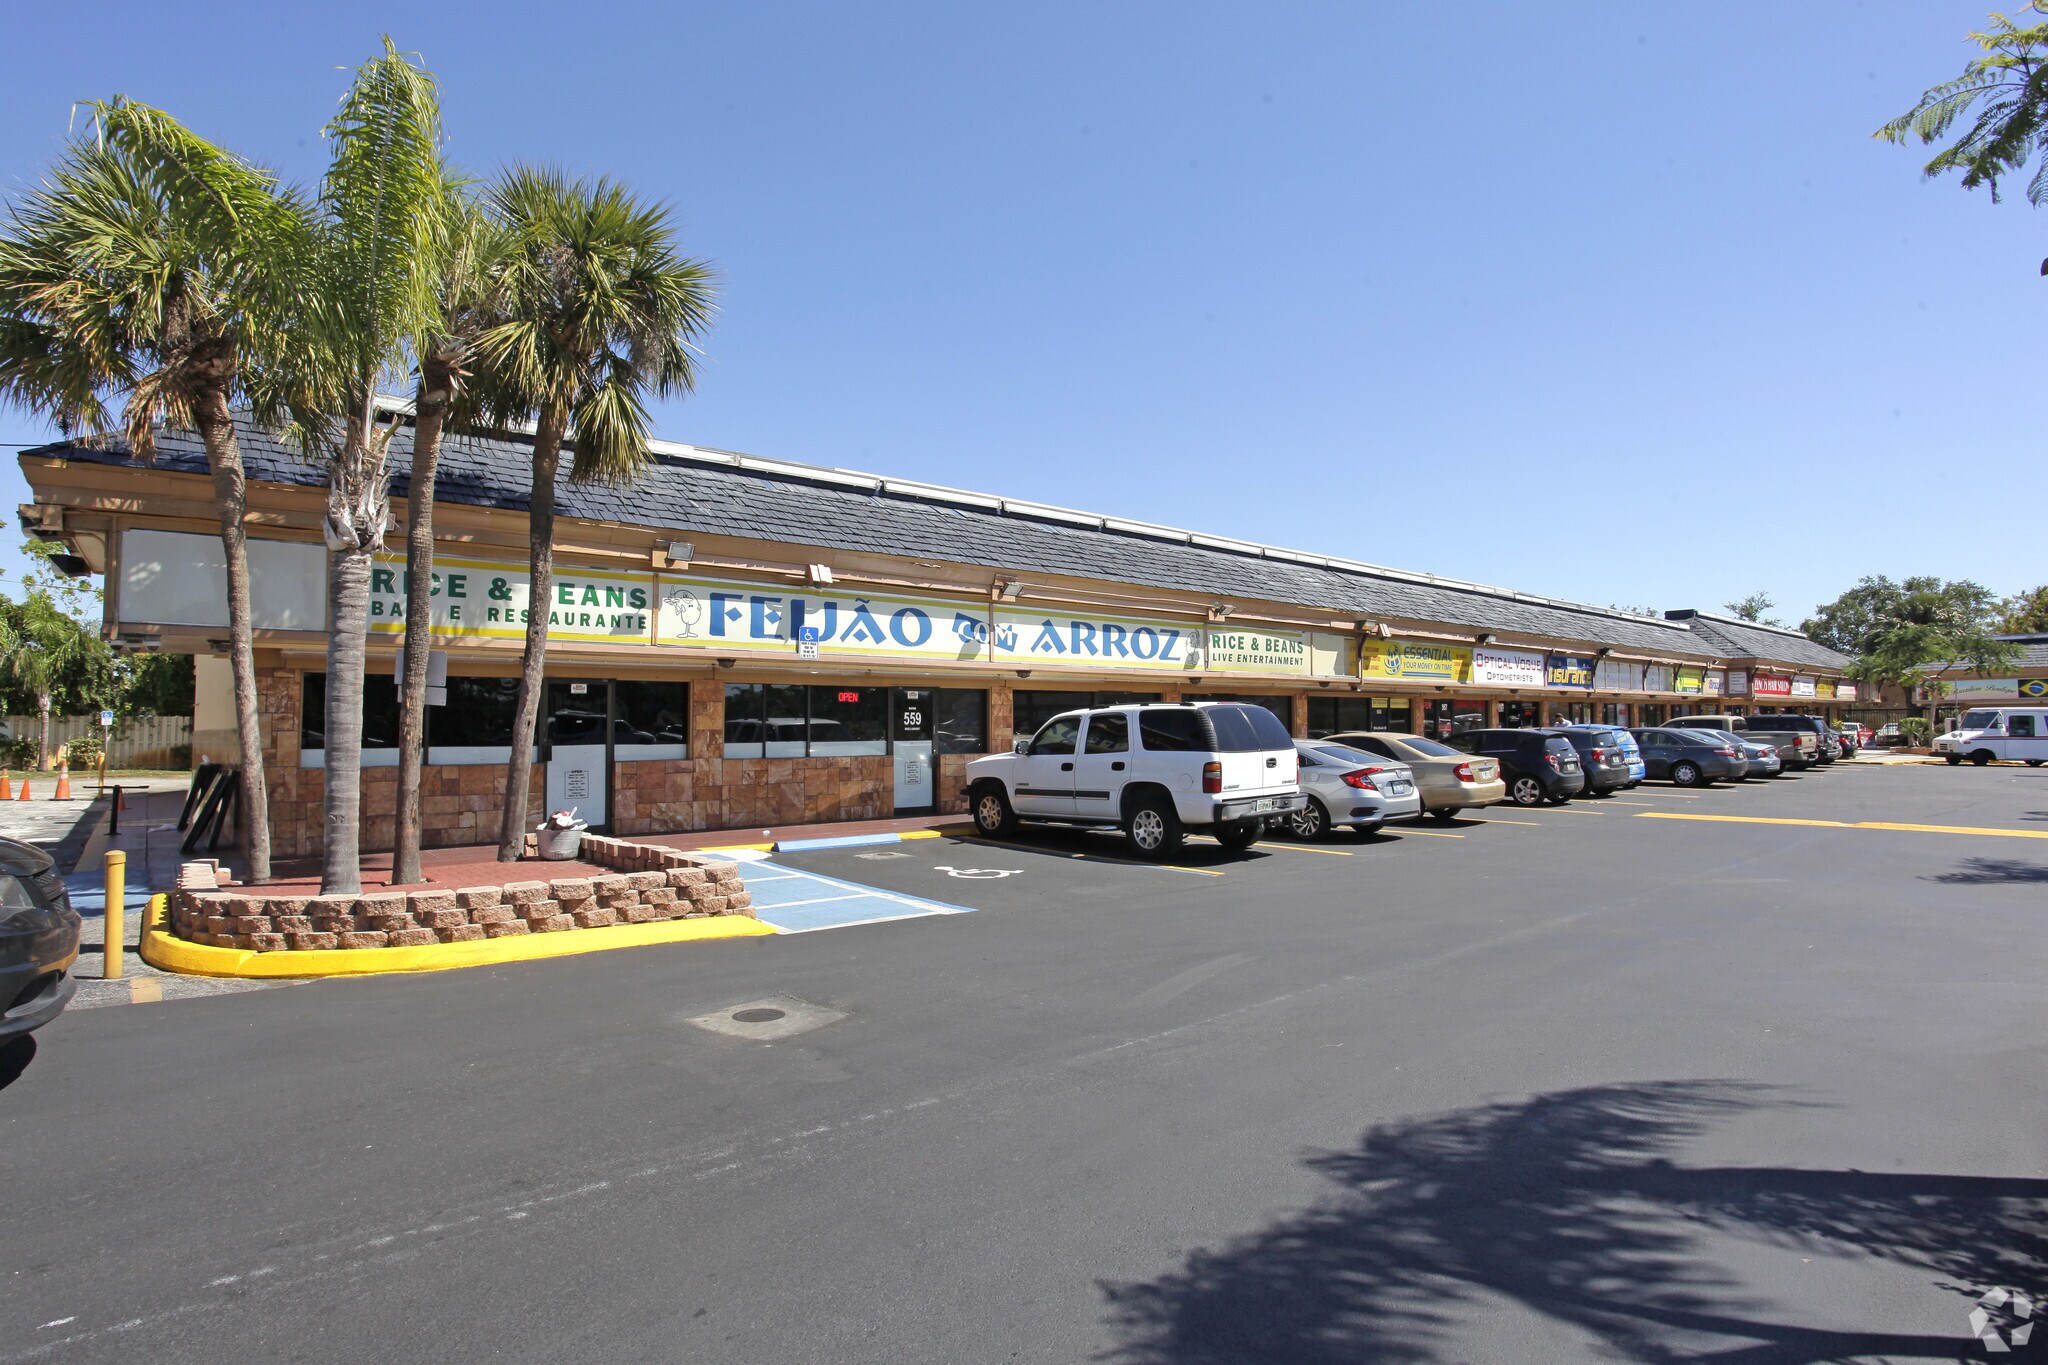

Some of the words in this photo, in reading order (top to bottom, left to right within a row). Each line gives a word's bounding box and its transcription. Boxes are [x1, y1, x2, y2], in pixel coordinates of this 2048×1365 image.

[488, 577, 513, 601] &
[557, 581, 648, 610] EANS
[449, 605, 462, 620] E
[487, 608, 648, 630] RESAURANTE
[709, 591, 933, 648] FEIJÃO
[957, 620, 1014, 647] COM
[1030, 618, 1181, 662] ARROZ
[1211, 634, 1245, 651] RICE
[1250, 636, 1260, 652] &
[1265, 638, 1304, 655] BEANS
[1212, 653, 1233, 662] LIVE
[1236, 654, 1304, 666] ENTERTAINMENT
[1403, 646, 1452, 661] ESSENTIAL
[1476, 652, 1513, 669] OPTICAL
[1403, 660, 1417, 669] YOUR
[1417, 661, 1434, 670] MONEY
[1486, 671, 1533, 682] OPTOMETRISTS
[838, 692, 859, 703] OPEN
[903, 711, 922, 726] 559
